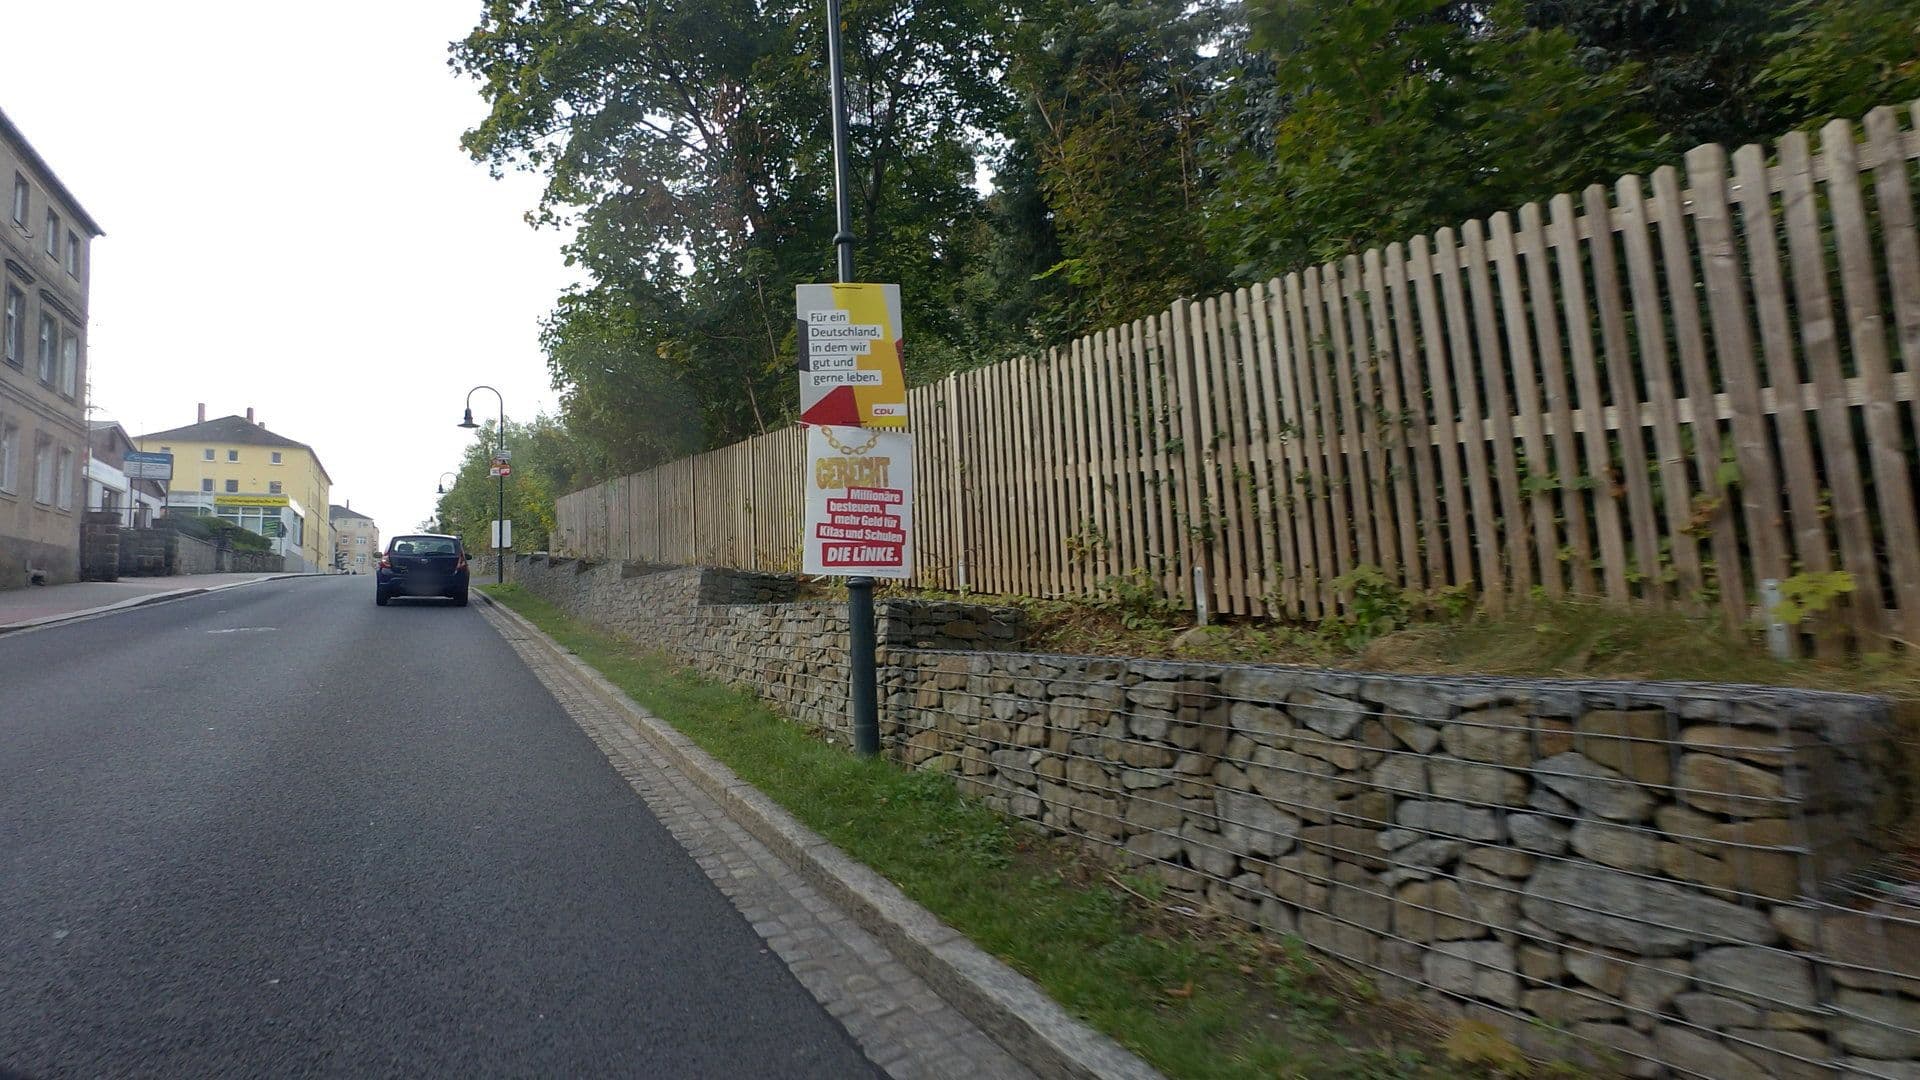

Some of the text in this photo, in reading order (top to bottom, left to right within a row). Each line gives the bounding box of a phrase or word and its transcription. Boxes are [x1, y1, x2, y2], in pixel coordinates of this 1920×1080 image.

[811, 312, 846, 322] Für ein
[811, 327, 880, 338] Deutschland,
[812, 342, 867, 352] in dem wir
[813, 357, 853, 370] gut und
[813, 373, 879, 385] gerne leben.
[850, 489, 901, 503] Millionäre
[830, 501, 883, 514] besteuern,
[835, 515, 897, 528] mehr Geld für
[819, 526, 844, 537] Kitas
[846, 528, 863, 539] und
[827, 545, 899, 562] DIE LINKE.
